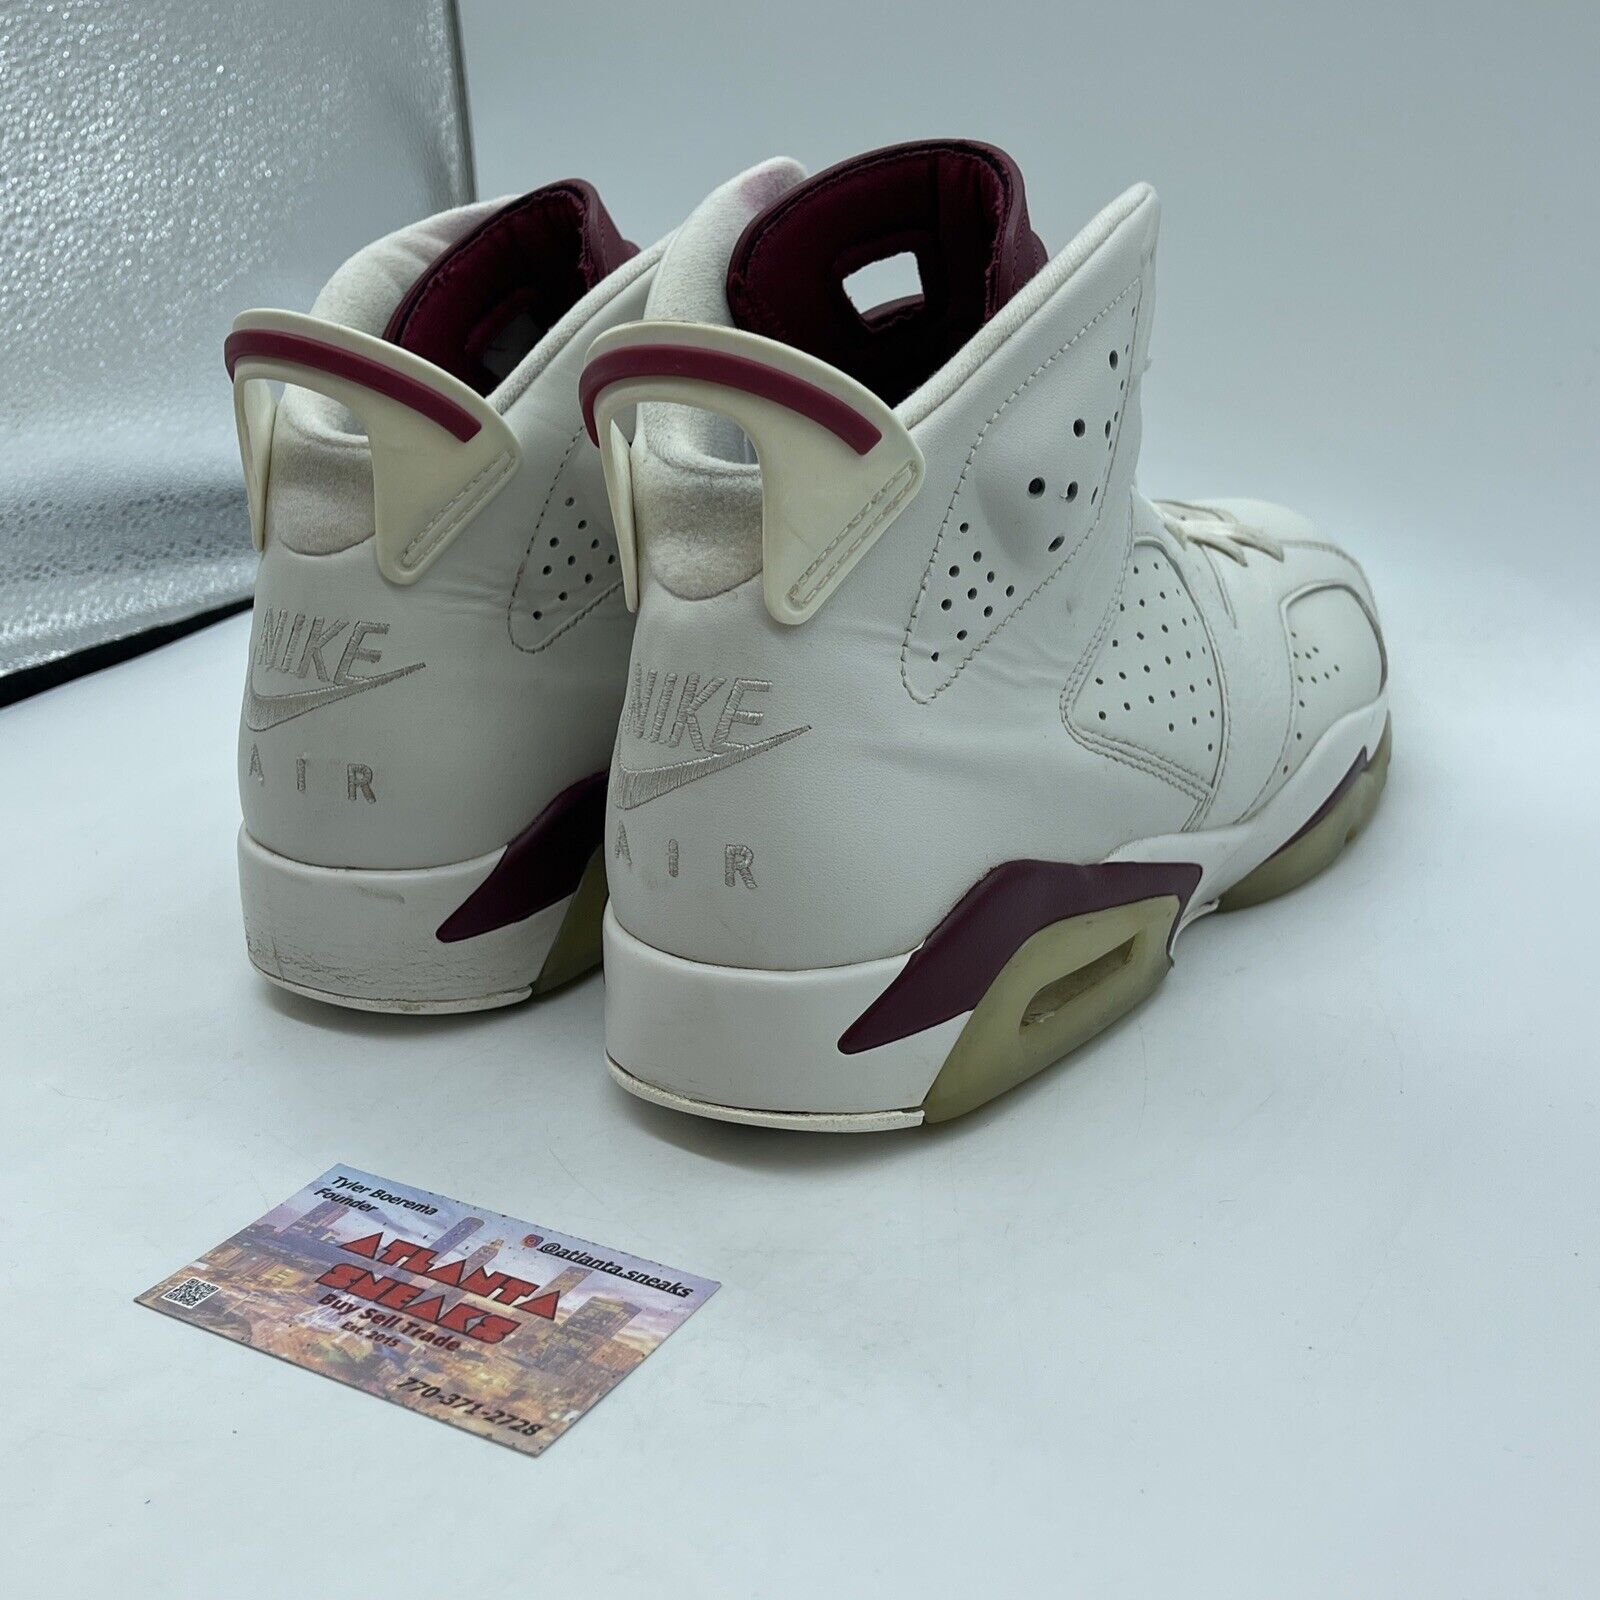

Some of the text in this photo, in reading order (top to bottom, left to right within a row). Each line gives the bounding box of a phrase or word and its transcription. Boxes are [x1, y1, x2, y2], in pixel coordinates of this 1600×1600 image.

[256, 608, 390, 686] NIKE
[626, 662, 773, 753] NIKE
[249, 743, 377, 803] AIR
[614, 820, 758, 889] AIR
[313, 1187, 379, 1213] Founder
[331, 1175, 439, 1216] Tyler Boerema
[337, 1231, 561, 1321] ATLANTA
[536, 1242, 694, 1299] @atlanta.sneaks
[314, 1263, 522, 1345] SNEAKS
[318, 1293, 462, 1351] Buy Sell Trade
[341, 1321, 401, 1348] Est. 2015
[396, 1376, 544, 1437] 770-371-2728
